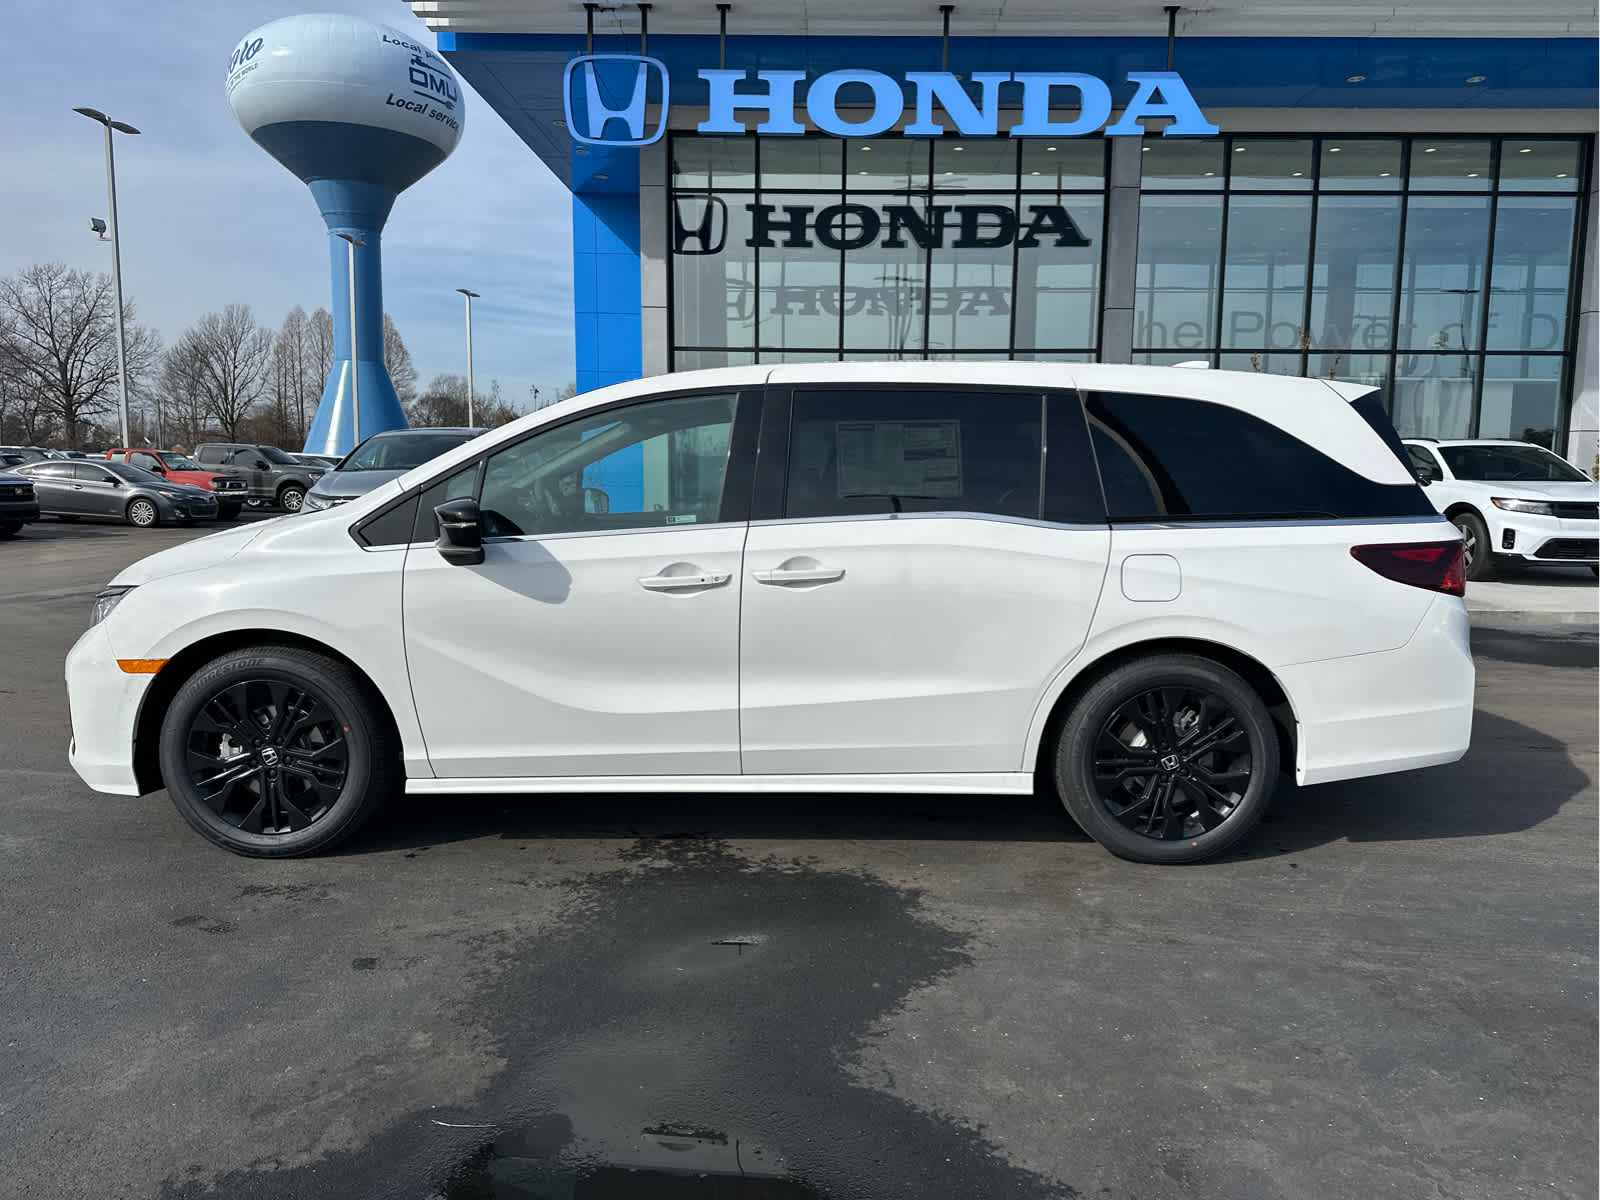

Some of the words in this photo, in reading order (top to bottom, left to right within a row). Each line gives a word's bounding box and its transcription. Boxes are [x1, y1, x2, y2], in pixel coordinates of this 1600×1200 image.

[381, 34, 421, 53] Local
[385, 93, 428, 114] Local
[408, 66, 458, 103] OMU
[697, 68, 1220, 137] HONDA
[745, 203, 1092, 250] HONDA
[1137, 310, 1204, 350] he
